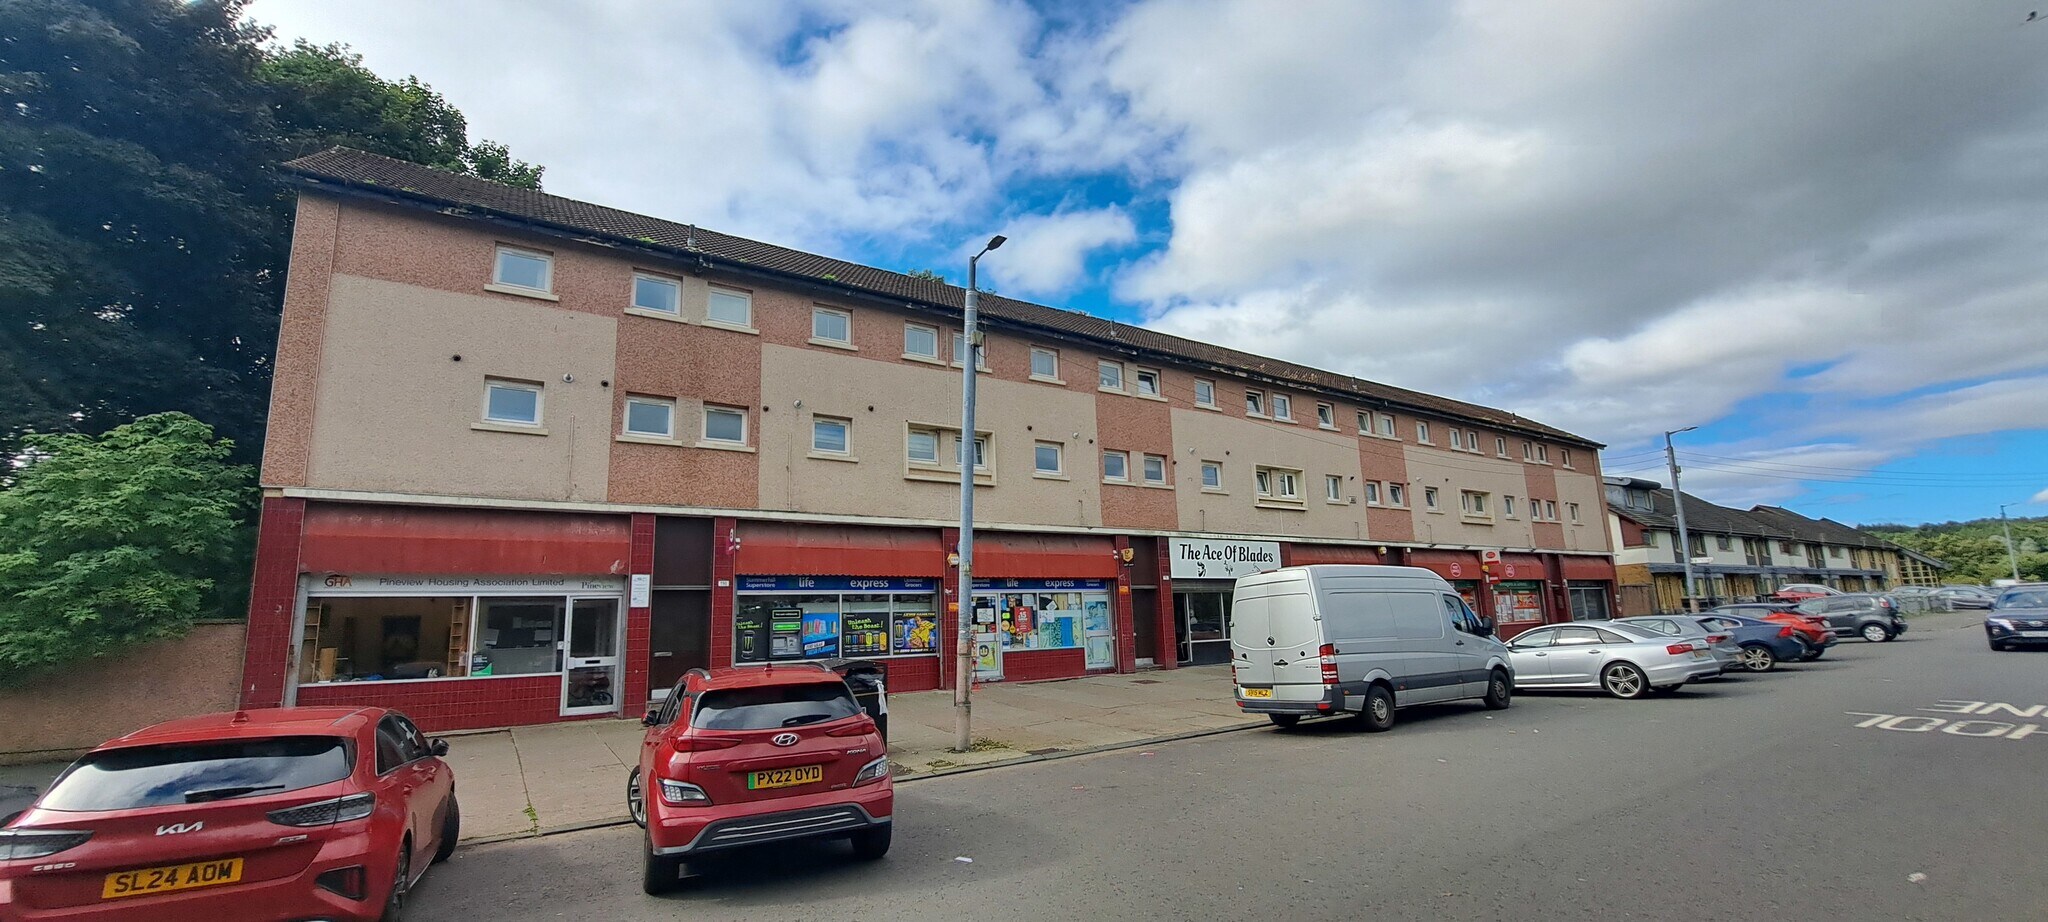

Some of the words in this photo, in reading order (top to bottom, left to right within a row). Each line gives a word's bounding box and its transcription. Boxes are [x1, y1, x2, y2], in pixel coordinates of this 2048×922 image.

[1179, 543, 1200, 560] The
[1202, 544, 1222, 560] Ace
[1224, 545, 1236, 562] Of
[1238, 546, 1274, 562] Blades
[324, 576, 352, 587] GHA
[379, 578, 424, 586] Pineview
[428, 578, 469, 587] Housing
[473, 578, 529, 586] Association
[532, 578, 565, 586] Limited
[798, 577, 815, 588] life
[850, 579, 889, 589] express
[1006, 578, 1019, 588] life
[1045, 580, 1075, 588] express
[757, 769, 792, 786] PX22
[795, 766, 820, 781] OYD
[114, 867, 178, 894] SL24
[186, 861, 233, 885] AOM
